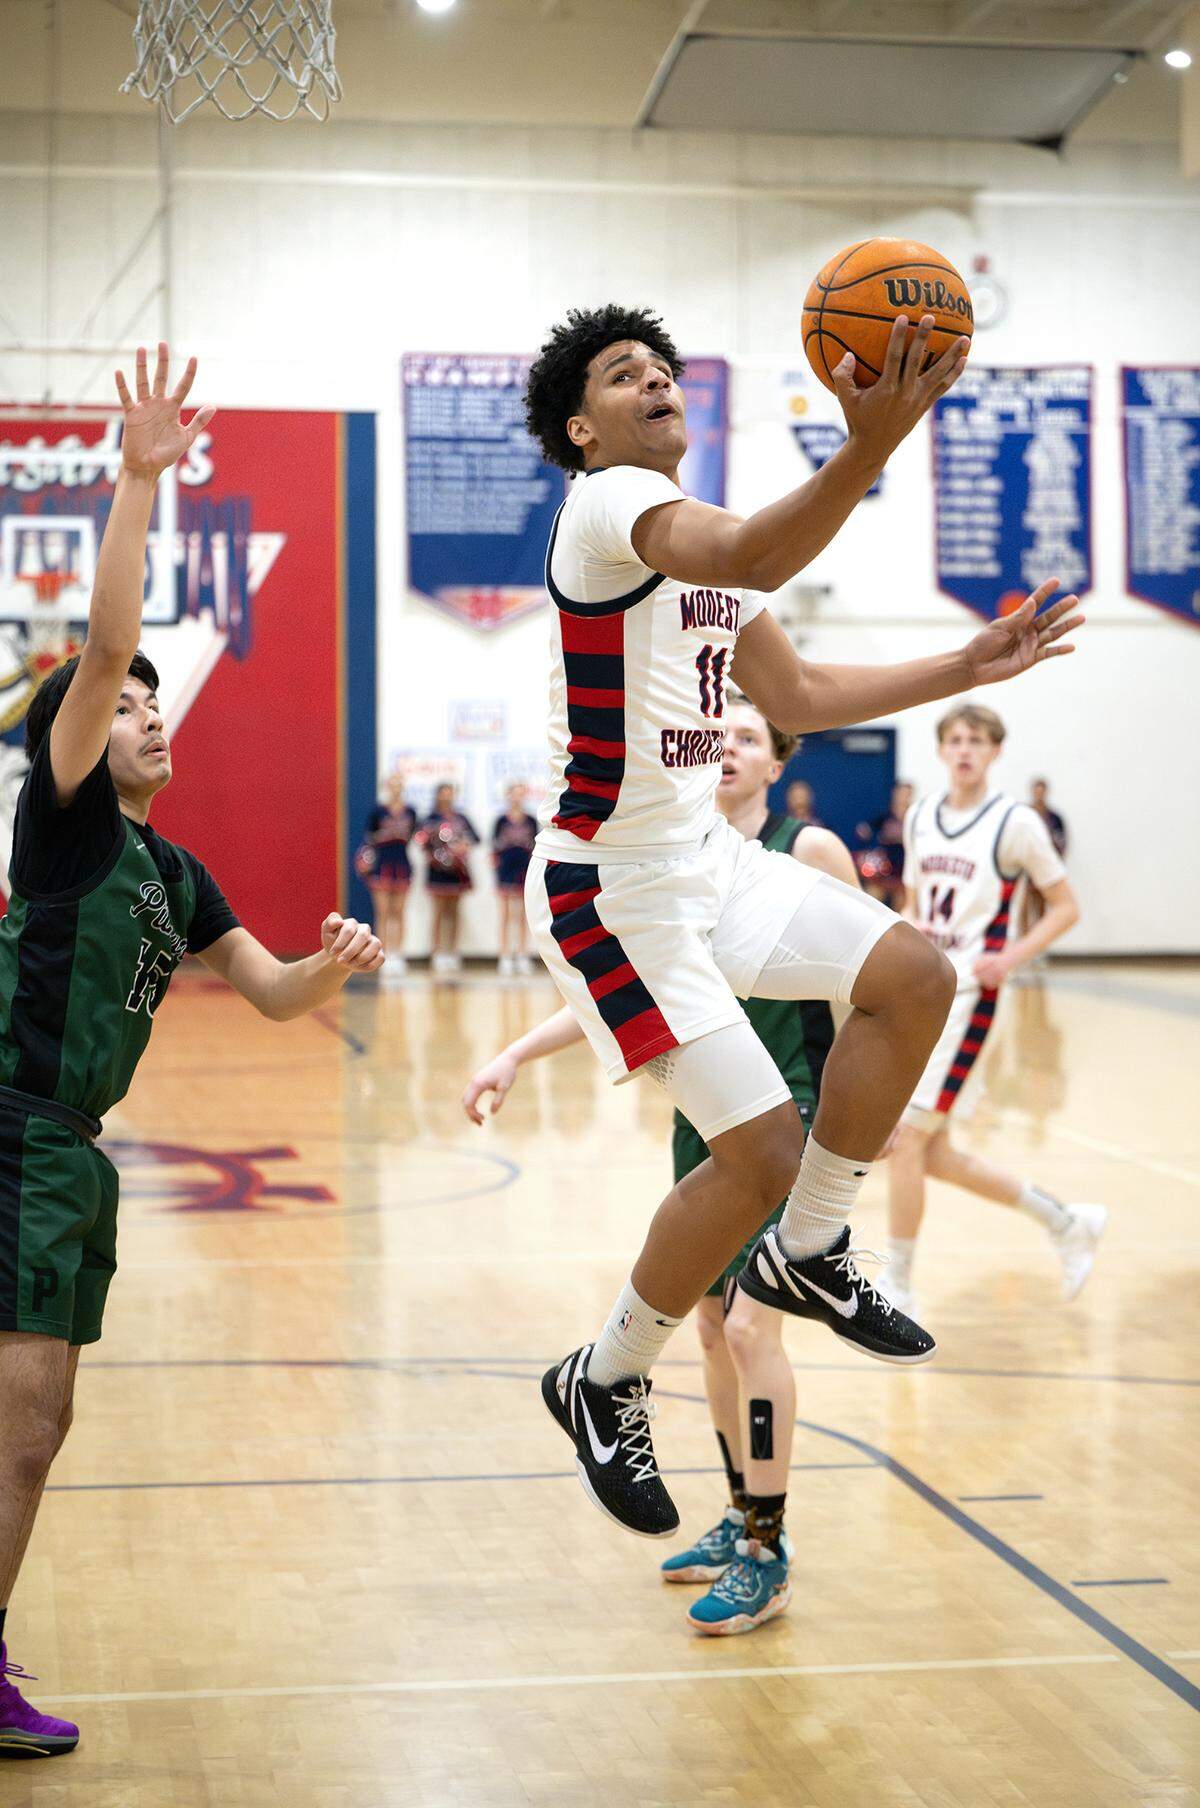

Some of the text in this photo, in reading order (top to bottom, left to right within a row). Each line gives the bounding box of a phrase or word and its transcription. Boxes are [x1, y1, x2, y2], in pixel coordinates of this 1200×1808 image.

[882, 278, 974, 321] Wilson
[695, 643, 728, 718] 11
[929, 884, 956, 923] 14
[31, 1267, 59, 1312] P
